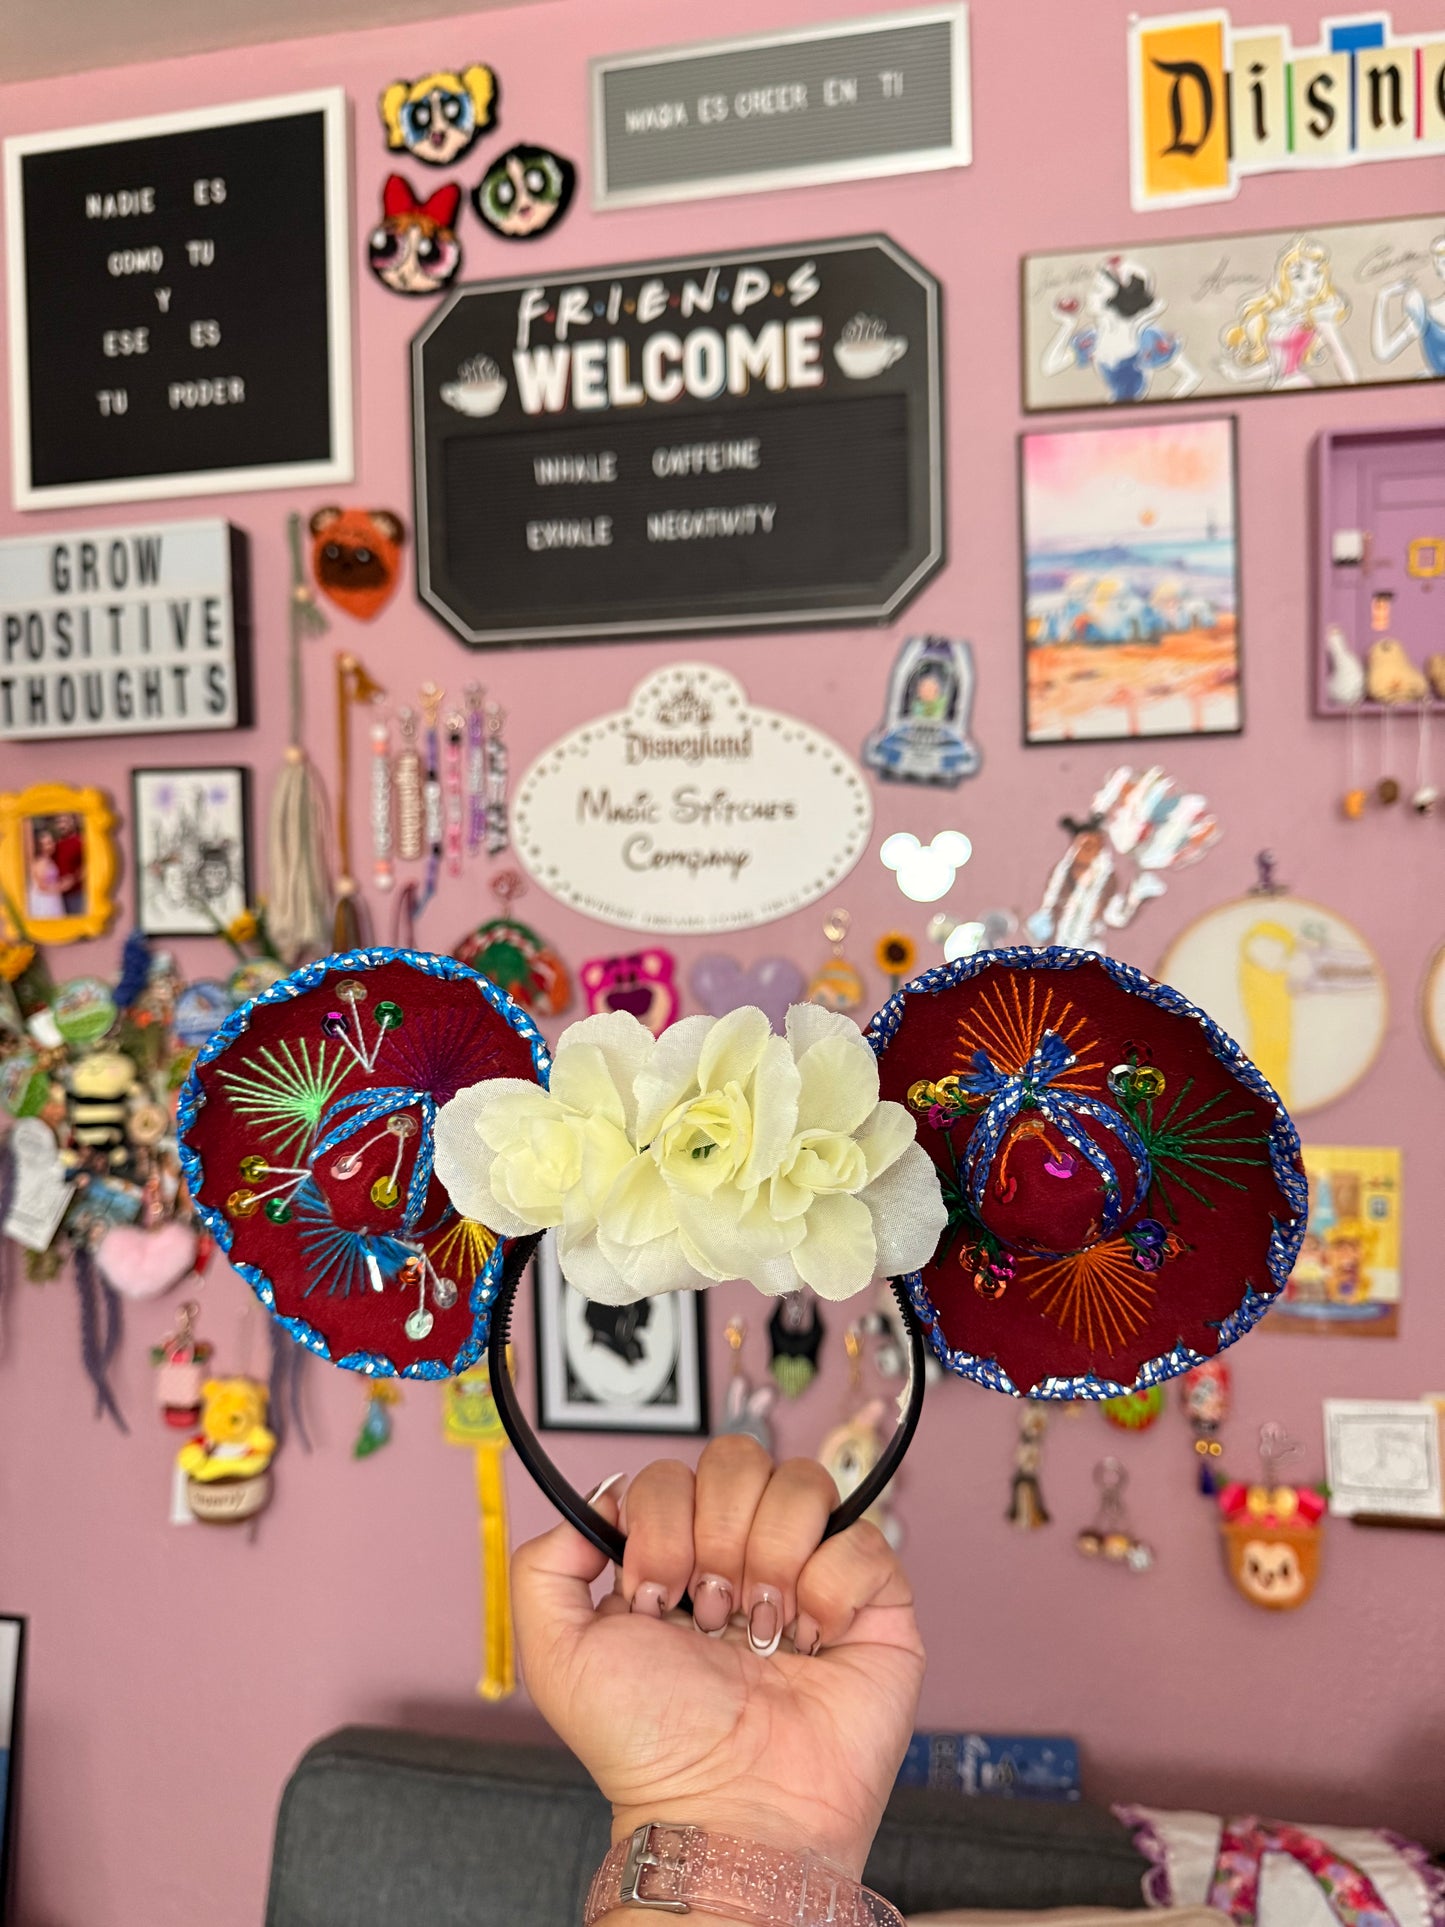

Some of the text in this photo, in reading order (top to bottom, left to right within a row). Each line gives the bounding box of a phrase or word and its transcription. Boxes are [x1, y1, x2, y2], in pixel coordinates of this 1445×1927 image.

[697, 95, 730, 125] ES
[822, 77, 858, 107] EN
[878, 70, 904, 97] TI
[86, 178, 228, 219] NADIE ES
[108, 240, 216, 277] COMO TU
[155, 288, 172, 313] Y
[103, 320, 222, 358] ESE ES
[514, 316, 822, 414] WELCOME
[97, 376, 247, 416] TU PODER
[534, 438, 760, 485] INHALE CAFFEINE
[527, 503, 777, 551] EXHALE NEGATIVITY
[51, 536, 162, 594] GROW
[5, 597, 223, 663] POSITIVE
[0, 664, 227, 726] THOUGHTS
[625, 729, 752, 766] Disneyland
[621, 831, 753, 882] Company
